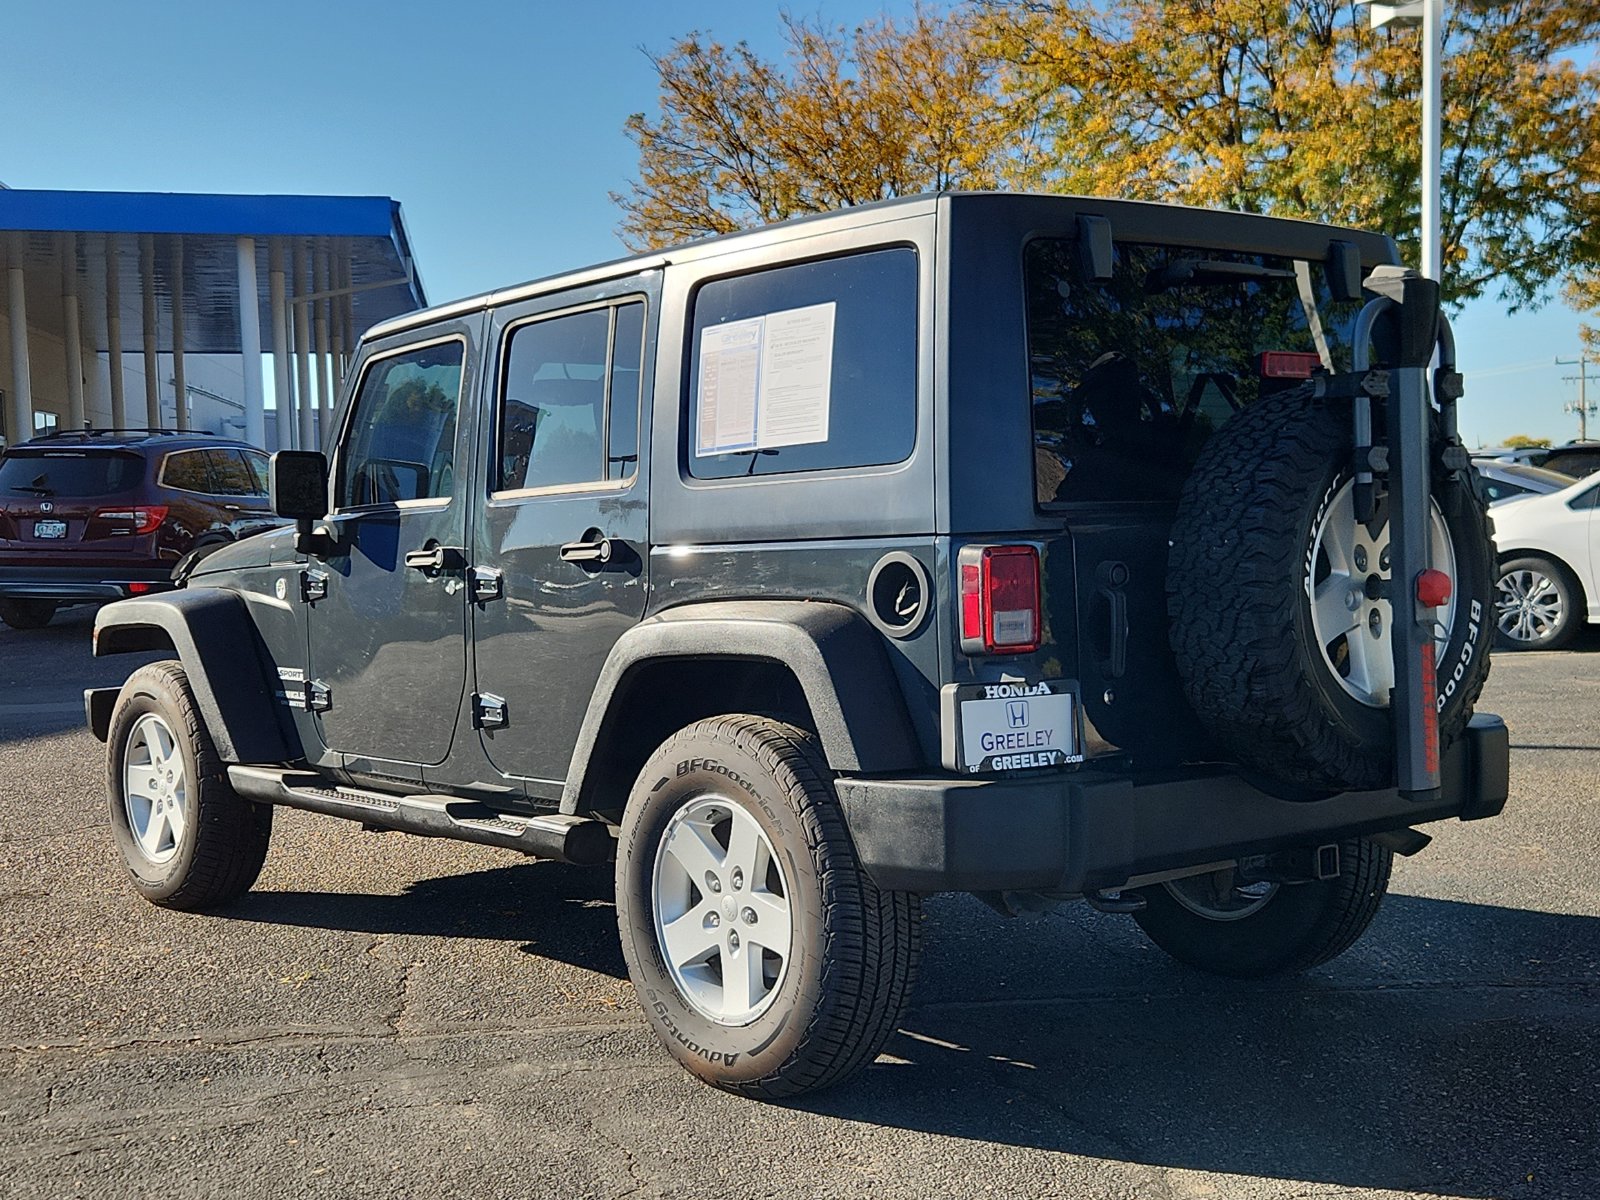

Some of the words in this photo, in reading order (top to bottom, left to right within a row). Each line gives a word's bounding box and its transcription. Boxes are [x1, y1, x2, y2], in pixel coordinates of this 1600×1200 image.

[1436, 599, 1482, 714] BFGood
[279, 669, 303, 678] SPORT
[981, 729, 1053, 751] GREELEY
[969, 764, 981, 773] OF
[991, 751, 1057, 771] GREELEY
[676, 757, 785, 839] BFGoodrich
